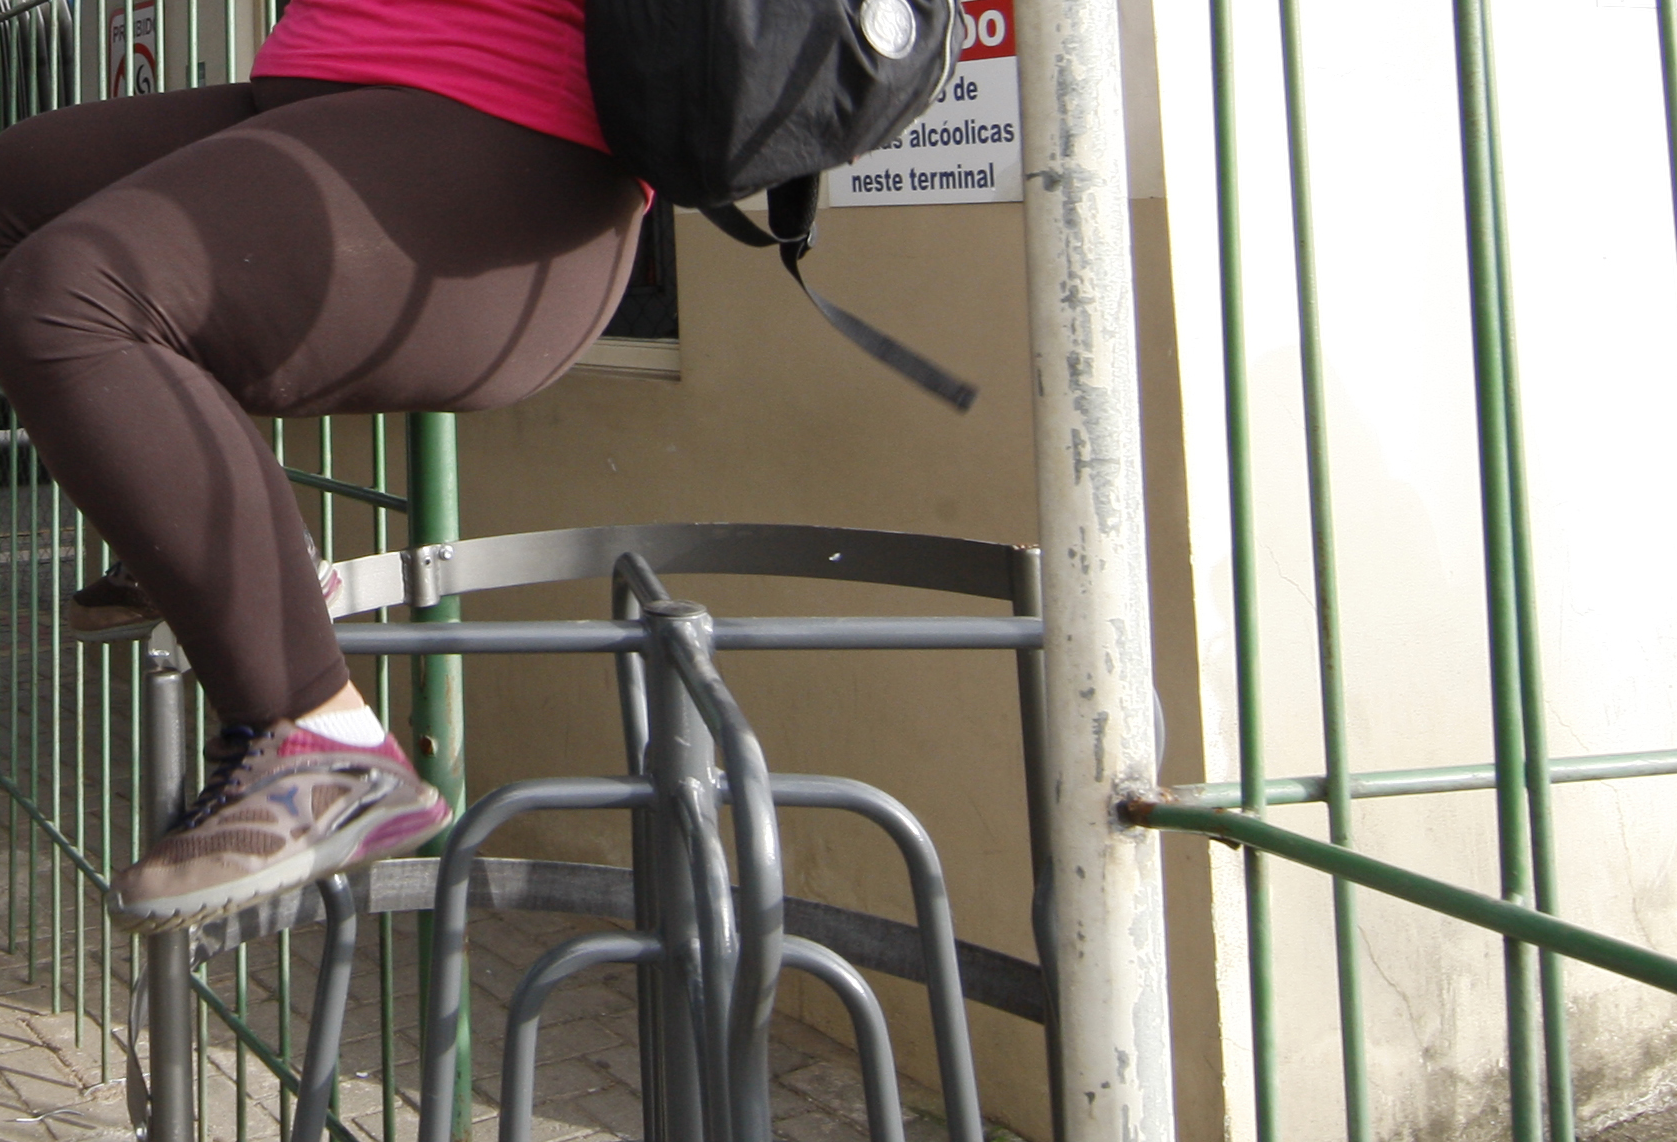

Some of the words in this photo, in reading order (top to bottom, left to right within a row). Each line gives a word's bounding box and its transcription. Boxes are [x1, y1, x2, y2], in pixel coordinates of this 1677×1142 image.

[954, 76, 978, 101] de
[910, 119, 1015, 148] alcóolicas
[852, 168, 903, 193] neste
[909, 162, 995, 192] terminal
